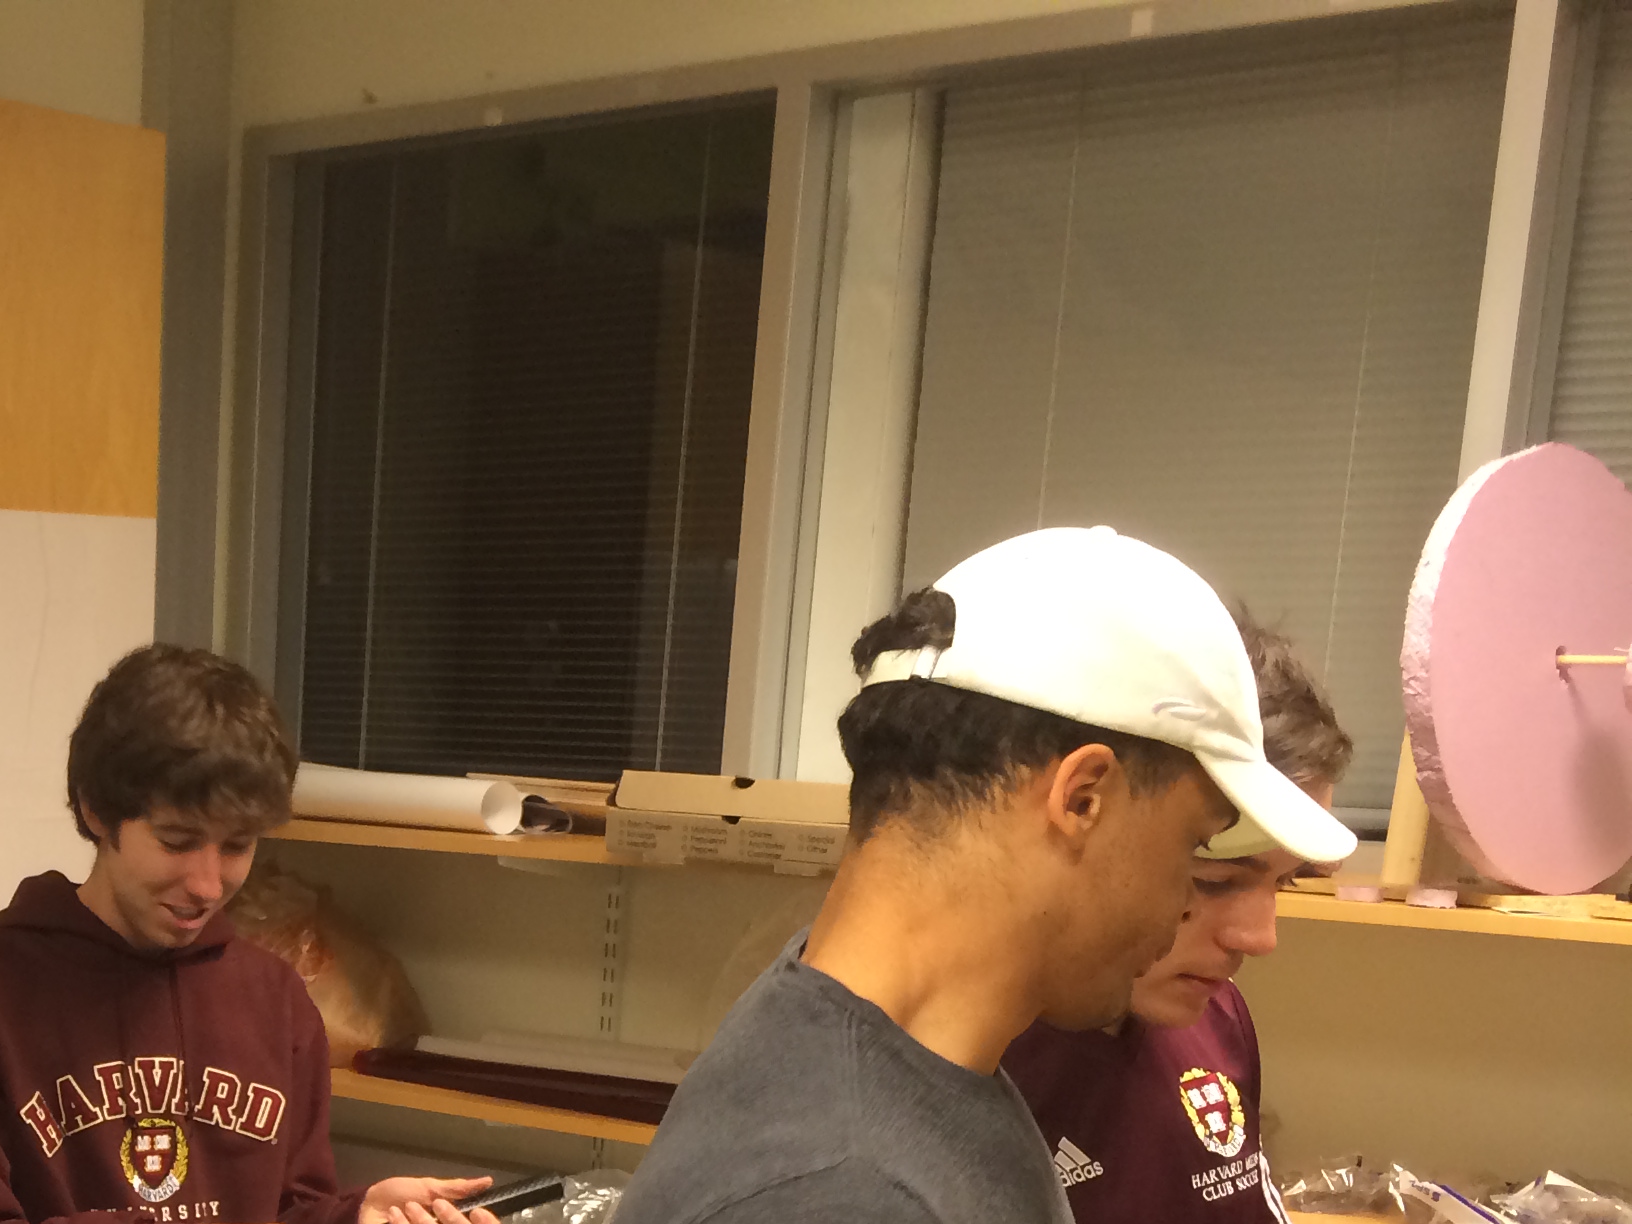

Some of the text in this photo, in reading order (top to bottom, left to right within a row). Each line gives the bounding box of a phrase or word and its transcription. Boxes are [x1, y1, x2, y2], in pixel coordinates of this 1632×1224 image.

[20, 1057, 286, 1158] HARVARD
[1059, 1159, 1104, 1188] didas
[1191, 1160, 1244, 1189] HARVARD
[1202, 1181, 1234, 1202] CLUB
